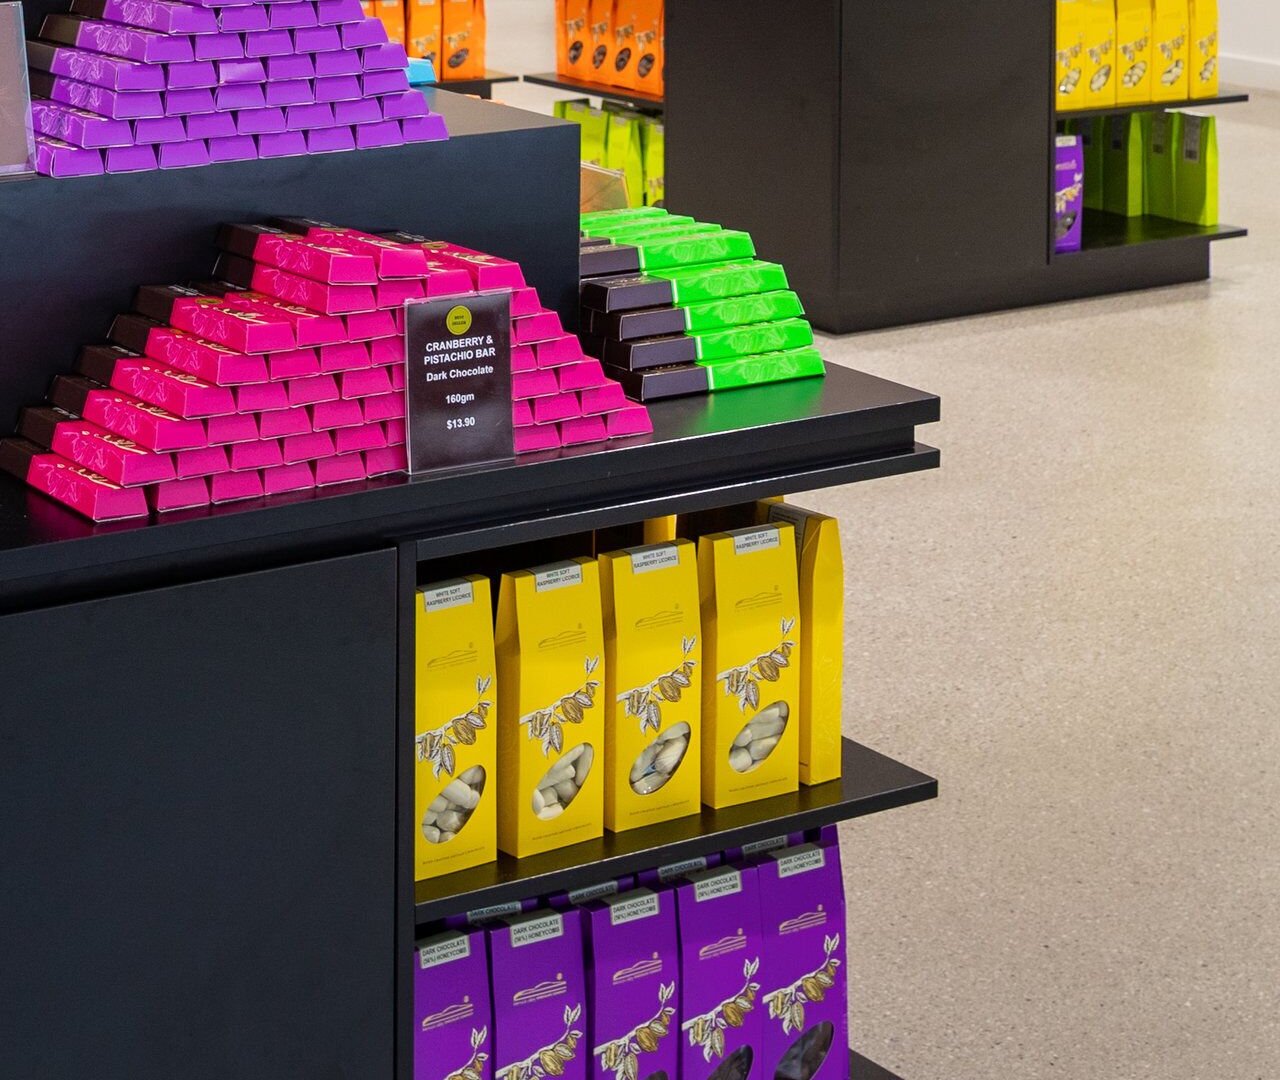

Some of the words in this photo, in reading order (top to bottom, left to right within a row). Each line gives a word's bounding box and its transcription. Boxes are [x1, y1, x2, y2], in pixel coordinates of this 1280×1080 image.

[425, 336, 484, 352] CRANBERRY
[486, 335, 493, 345] &
[424, 350, 474, 365] PISTACHIO
[475, 347, 496, 358] BAR
[426, 372, 448, 382] Dark
[449, 365, 494, 379] Chocolate
[445, 392, 475, 404] 160gm
[446, 416, 476, 430] $13.90
[736, 540, 760, 550] RASPBERRY
[760, 537, 778, 545] LICORICE
[744, 534, 757, 542] WHITE
[634, 559, 658, 568] RASPBERRY
[658, 555, 677, 564] LICORICE
[642, 552, 655, 560] WHITE
[655, 550, 666, 558] SOFT
[546, 570, 559, 578] WHITE
[559, 568, 570, 576] SOFT
[537, 578, 562, 587] RASPBERRY
[563, 573, 580, 582] LICORICE
[426, 597, 451, 606] RASPBERRY
[452, 592, 471, 602] LICORICE
[436, 590, 449, 598] WHITE
[450, 587, 460, 595] SOFT
[757, 837, 784, 848] CHOCOLATE
[780, 858, 793, 866] DARK
[793, 851, 820, 862] CHOCOLATE
[793, 859, 820, 870] HONEYCOMB
[674, 860, 703, 871] CHOCOLATE
[710, 876, 737, 887] CHOCOLATE
[585, 885, 615, 897] CHOCOLATE
[710, 883, 738, 894] HONEYCOMB
[485, 903, 517, 915] CHOCOLATE
[613, 906, 626, 914] DARK
[627, 898, 655, 909] CHOCOLATE
[627, 905, 656, 917] HONEYCOMB
[513, 926, 527, 935] DARK
[528, 920, 559, 931] CHOCOLATE
[528, 927, 560, 940] HONEYCOMB
[422, 948, 436, 956] DARK
[436, 940, 465, 952] CHOCOLATE
[436, 948, 467, 962] HONEYCOMB
